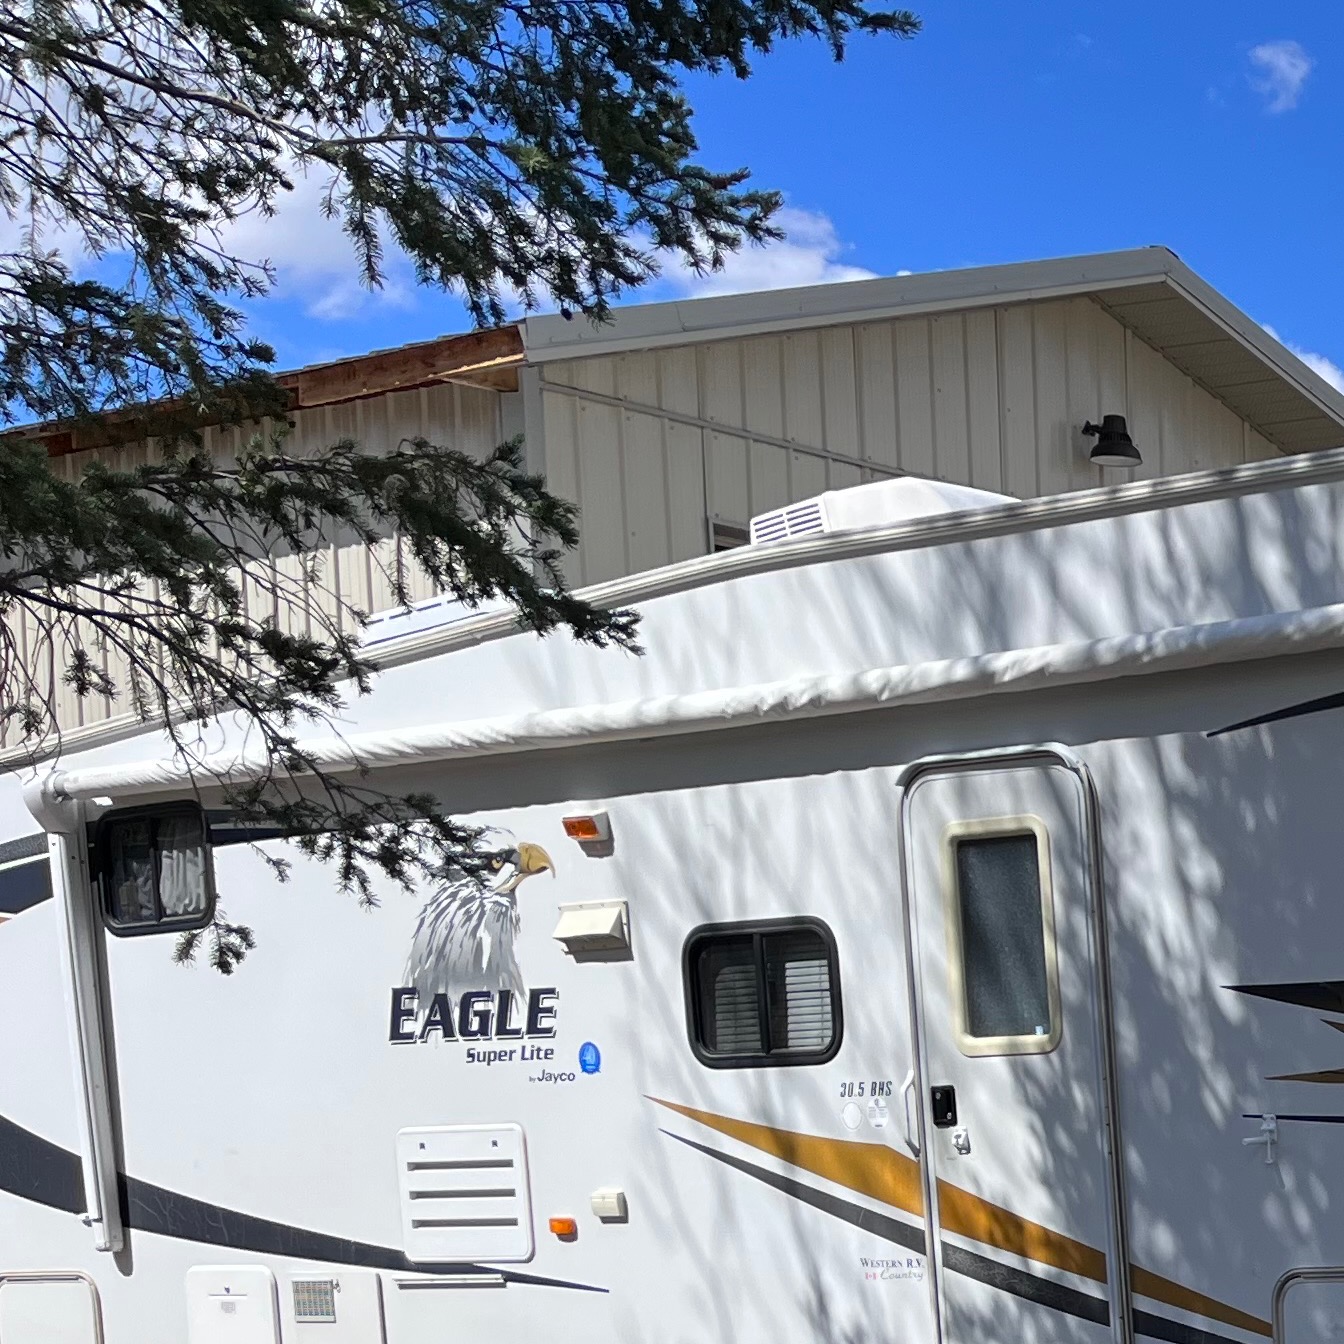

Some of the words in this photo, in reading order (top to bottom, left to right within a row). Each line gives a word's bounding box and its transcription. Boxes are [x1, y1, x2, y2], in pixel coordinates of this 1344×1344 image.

[388, 987, 560, 1045] EAGLE
[465, 1047, 517, 1067] Super
[520, 1044, 555, 1062] Lite
[536, 1069, 577, 1084] Jayco
[839, 1081, 866, 1098] 30.5
[869, 1080, 893, 1097] BHS
[859, 1257, 904, 1268] WESTERN
[880, 1267, 924, 1282] Country
